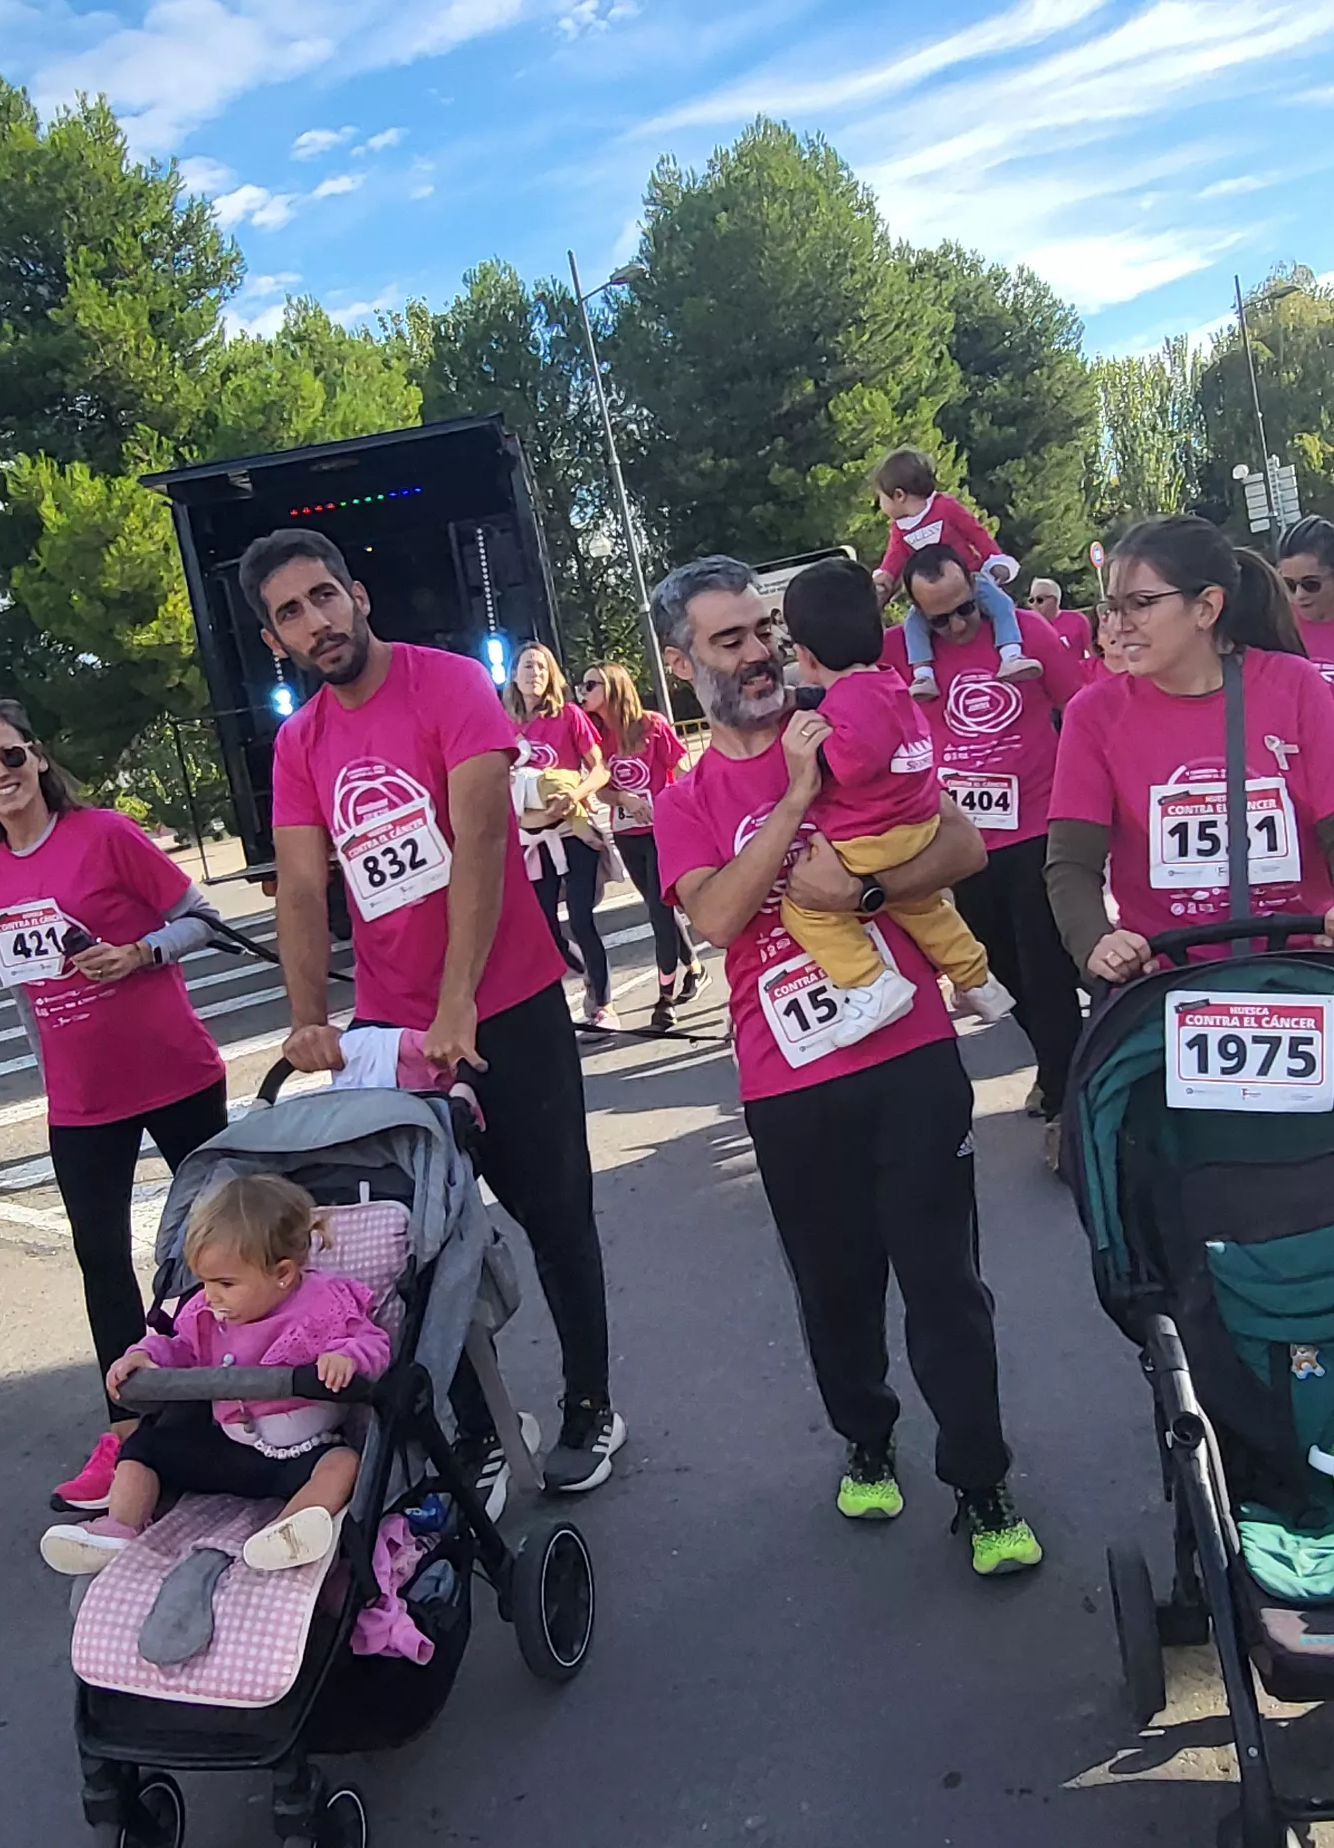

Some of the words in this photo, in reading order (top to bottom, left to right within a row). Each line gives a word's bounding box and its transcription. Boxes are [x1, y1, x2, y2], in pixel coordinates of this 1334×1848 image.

[949, 789, 1011, 812] 1404
[1167, 804, 1214, 816] CONTRA
[363, 837, 428, 888] 832
[13, 926, 63, 959] 421
[773, 973, 819, 998] CONTRA
[1185, 1014, 1241, 1027] CONTRA
[1243, 1017, 1259, 1028] EL
[1261, 1015, 1316, 1029] CÁNCER
[1185, 1033, 1317, 1079] 1975
